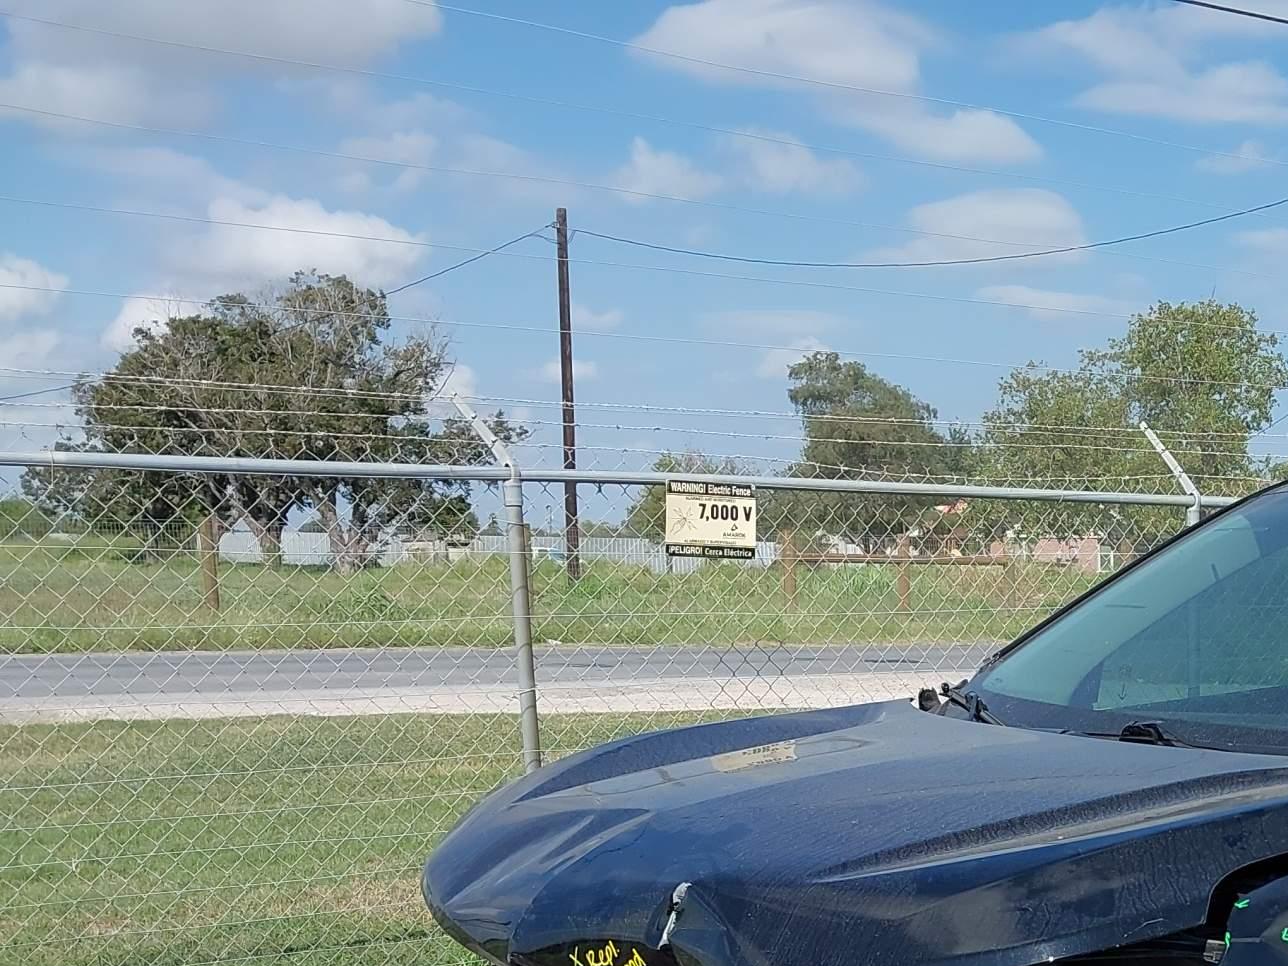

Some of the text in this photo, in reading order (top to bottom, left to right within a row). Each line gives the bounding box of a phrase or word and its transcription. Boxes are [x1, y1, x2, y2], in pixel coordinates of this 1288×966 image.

[670, 481, 751, 497] WARNING! Electric Fence
[698, 503, 752, 522] 7,000 V
[704, 547, 722, 556] Cerca
